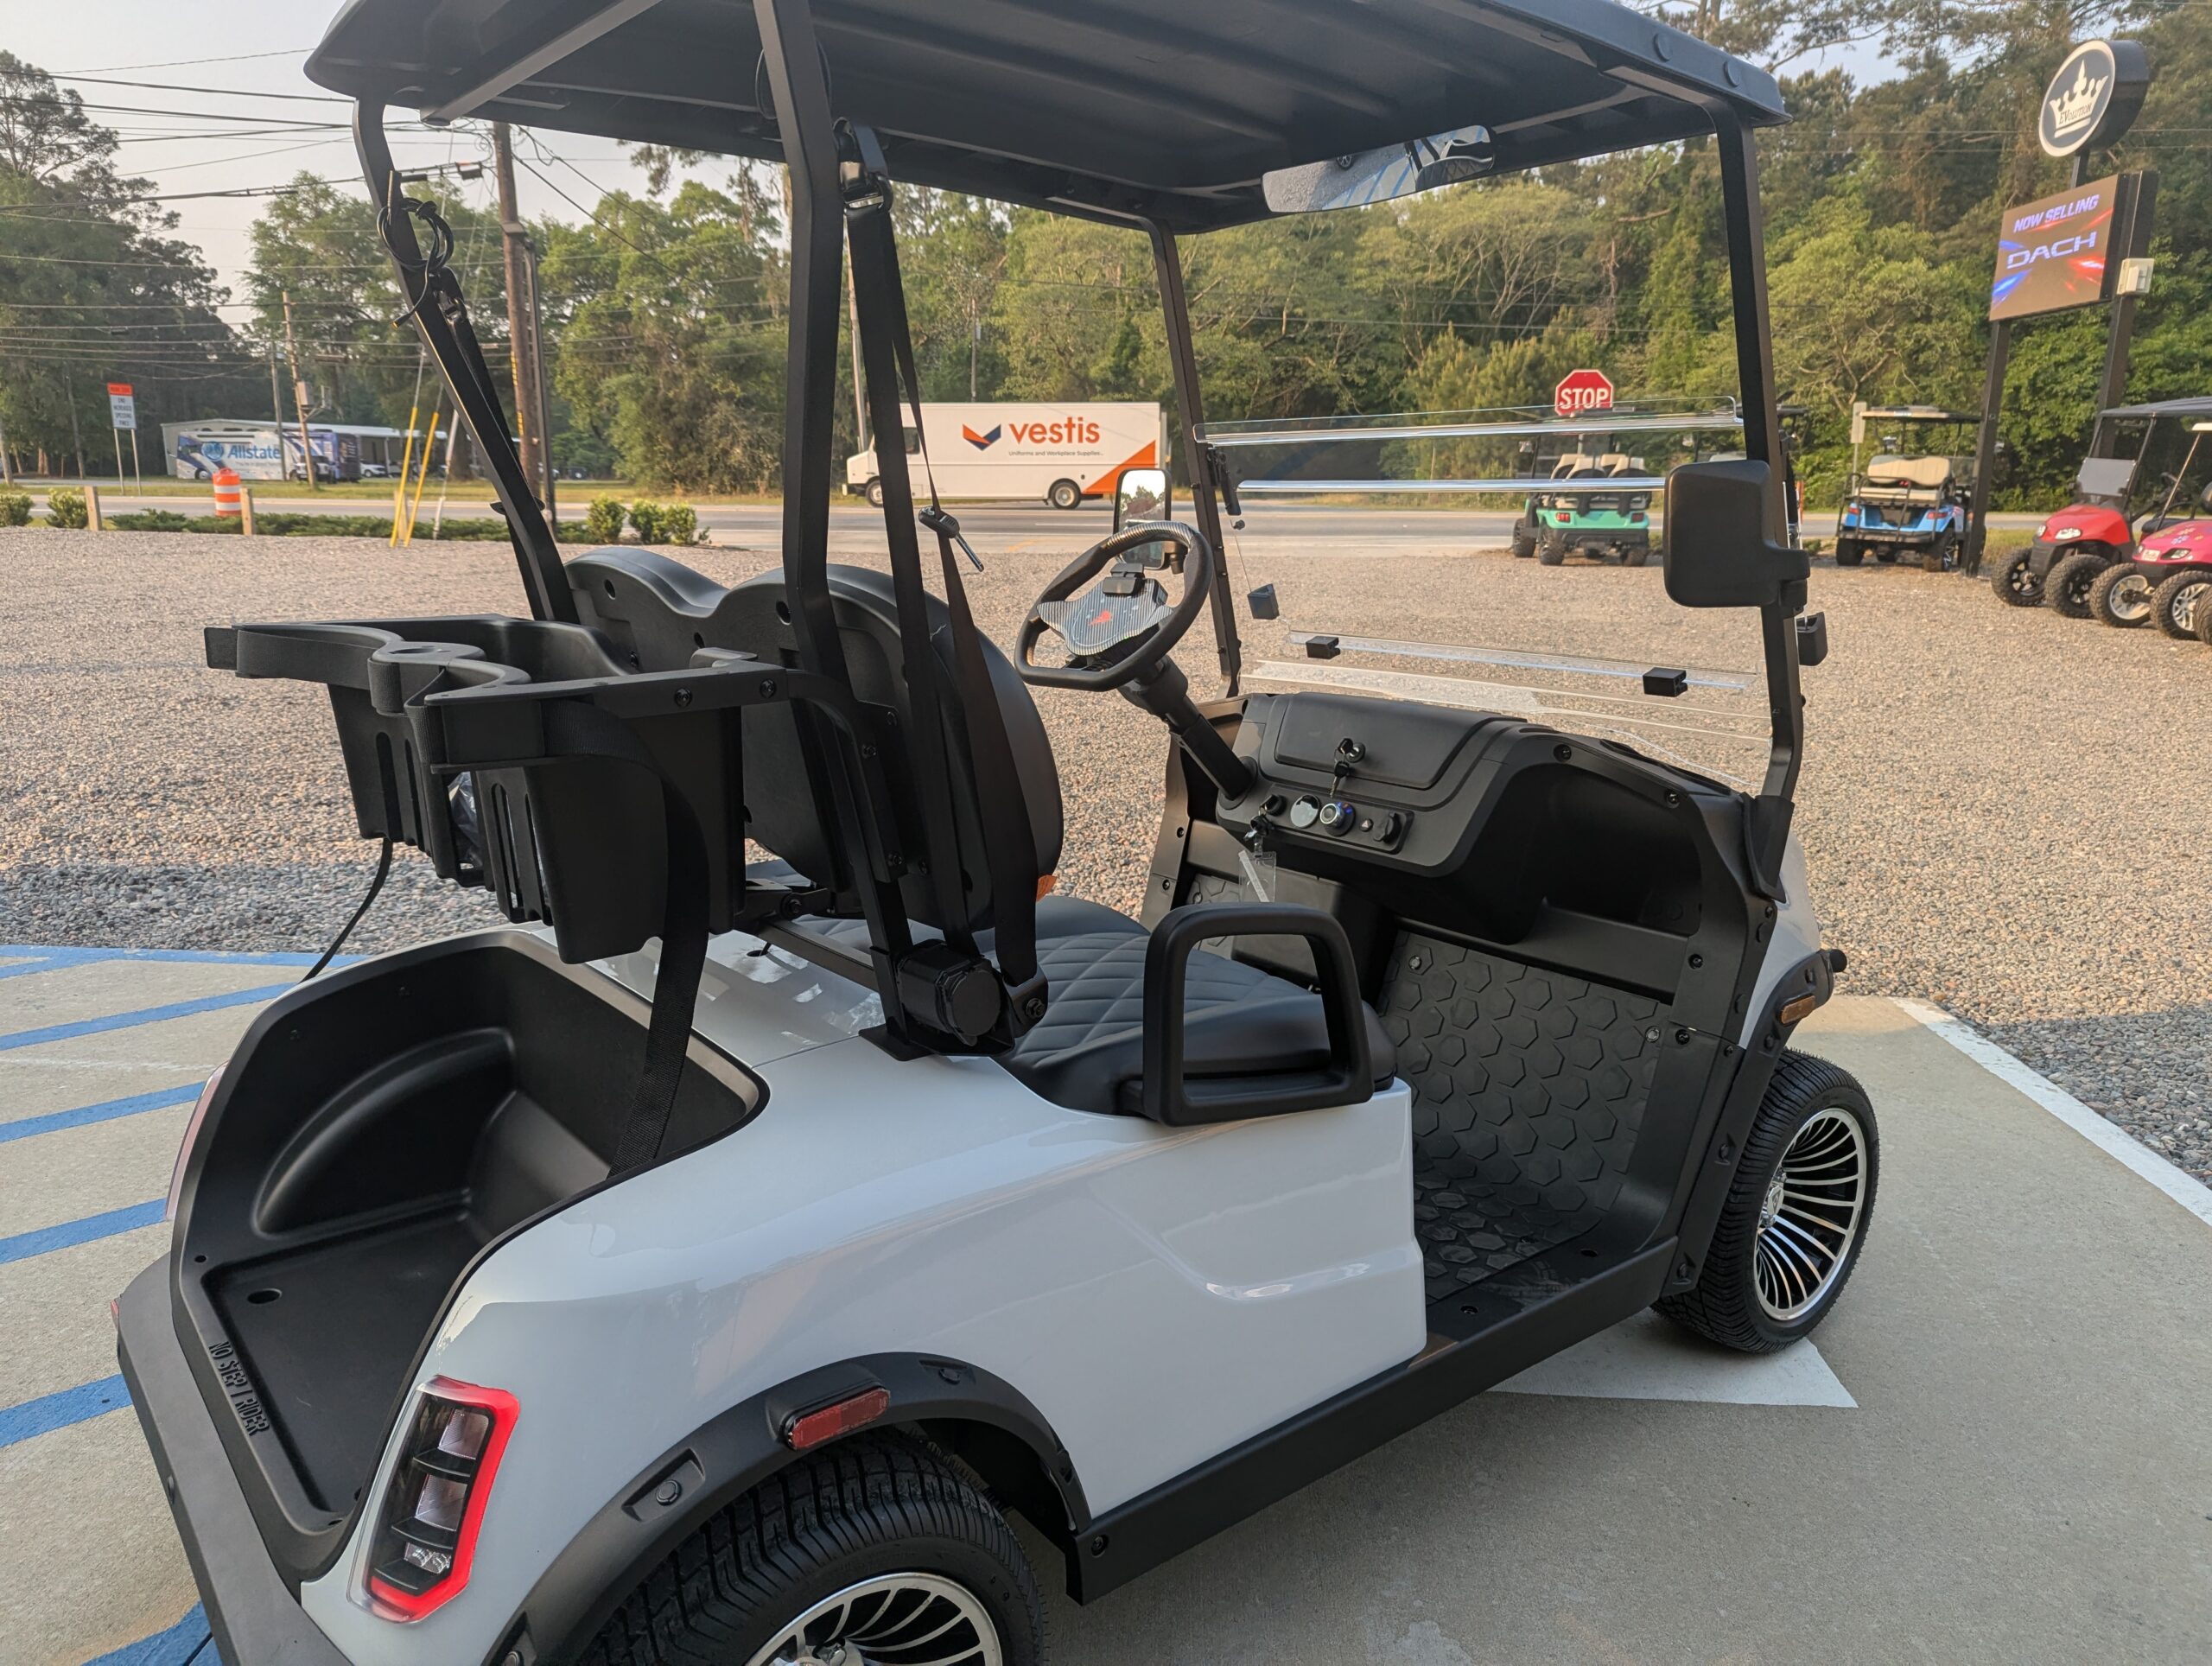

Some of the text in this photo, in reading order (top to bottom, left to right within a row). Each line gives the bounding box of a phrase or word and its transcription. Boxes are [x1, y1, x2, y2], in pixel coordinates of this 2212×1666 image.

[2012, 194, 2100, 233] NOW SELLING
[2006, 232, 2098, 270] DACH
[1560, 387, 1609, 410] STOP
[1008, 416, 1101, 445] vestis
[227, 445, 282, 460] Allstate
[208, 1340, 234, 1360] NO
[217, 1360, 249, 1388] STEP
[235, 1396, 270, 1437] RIDER
